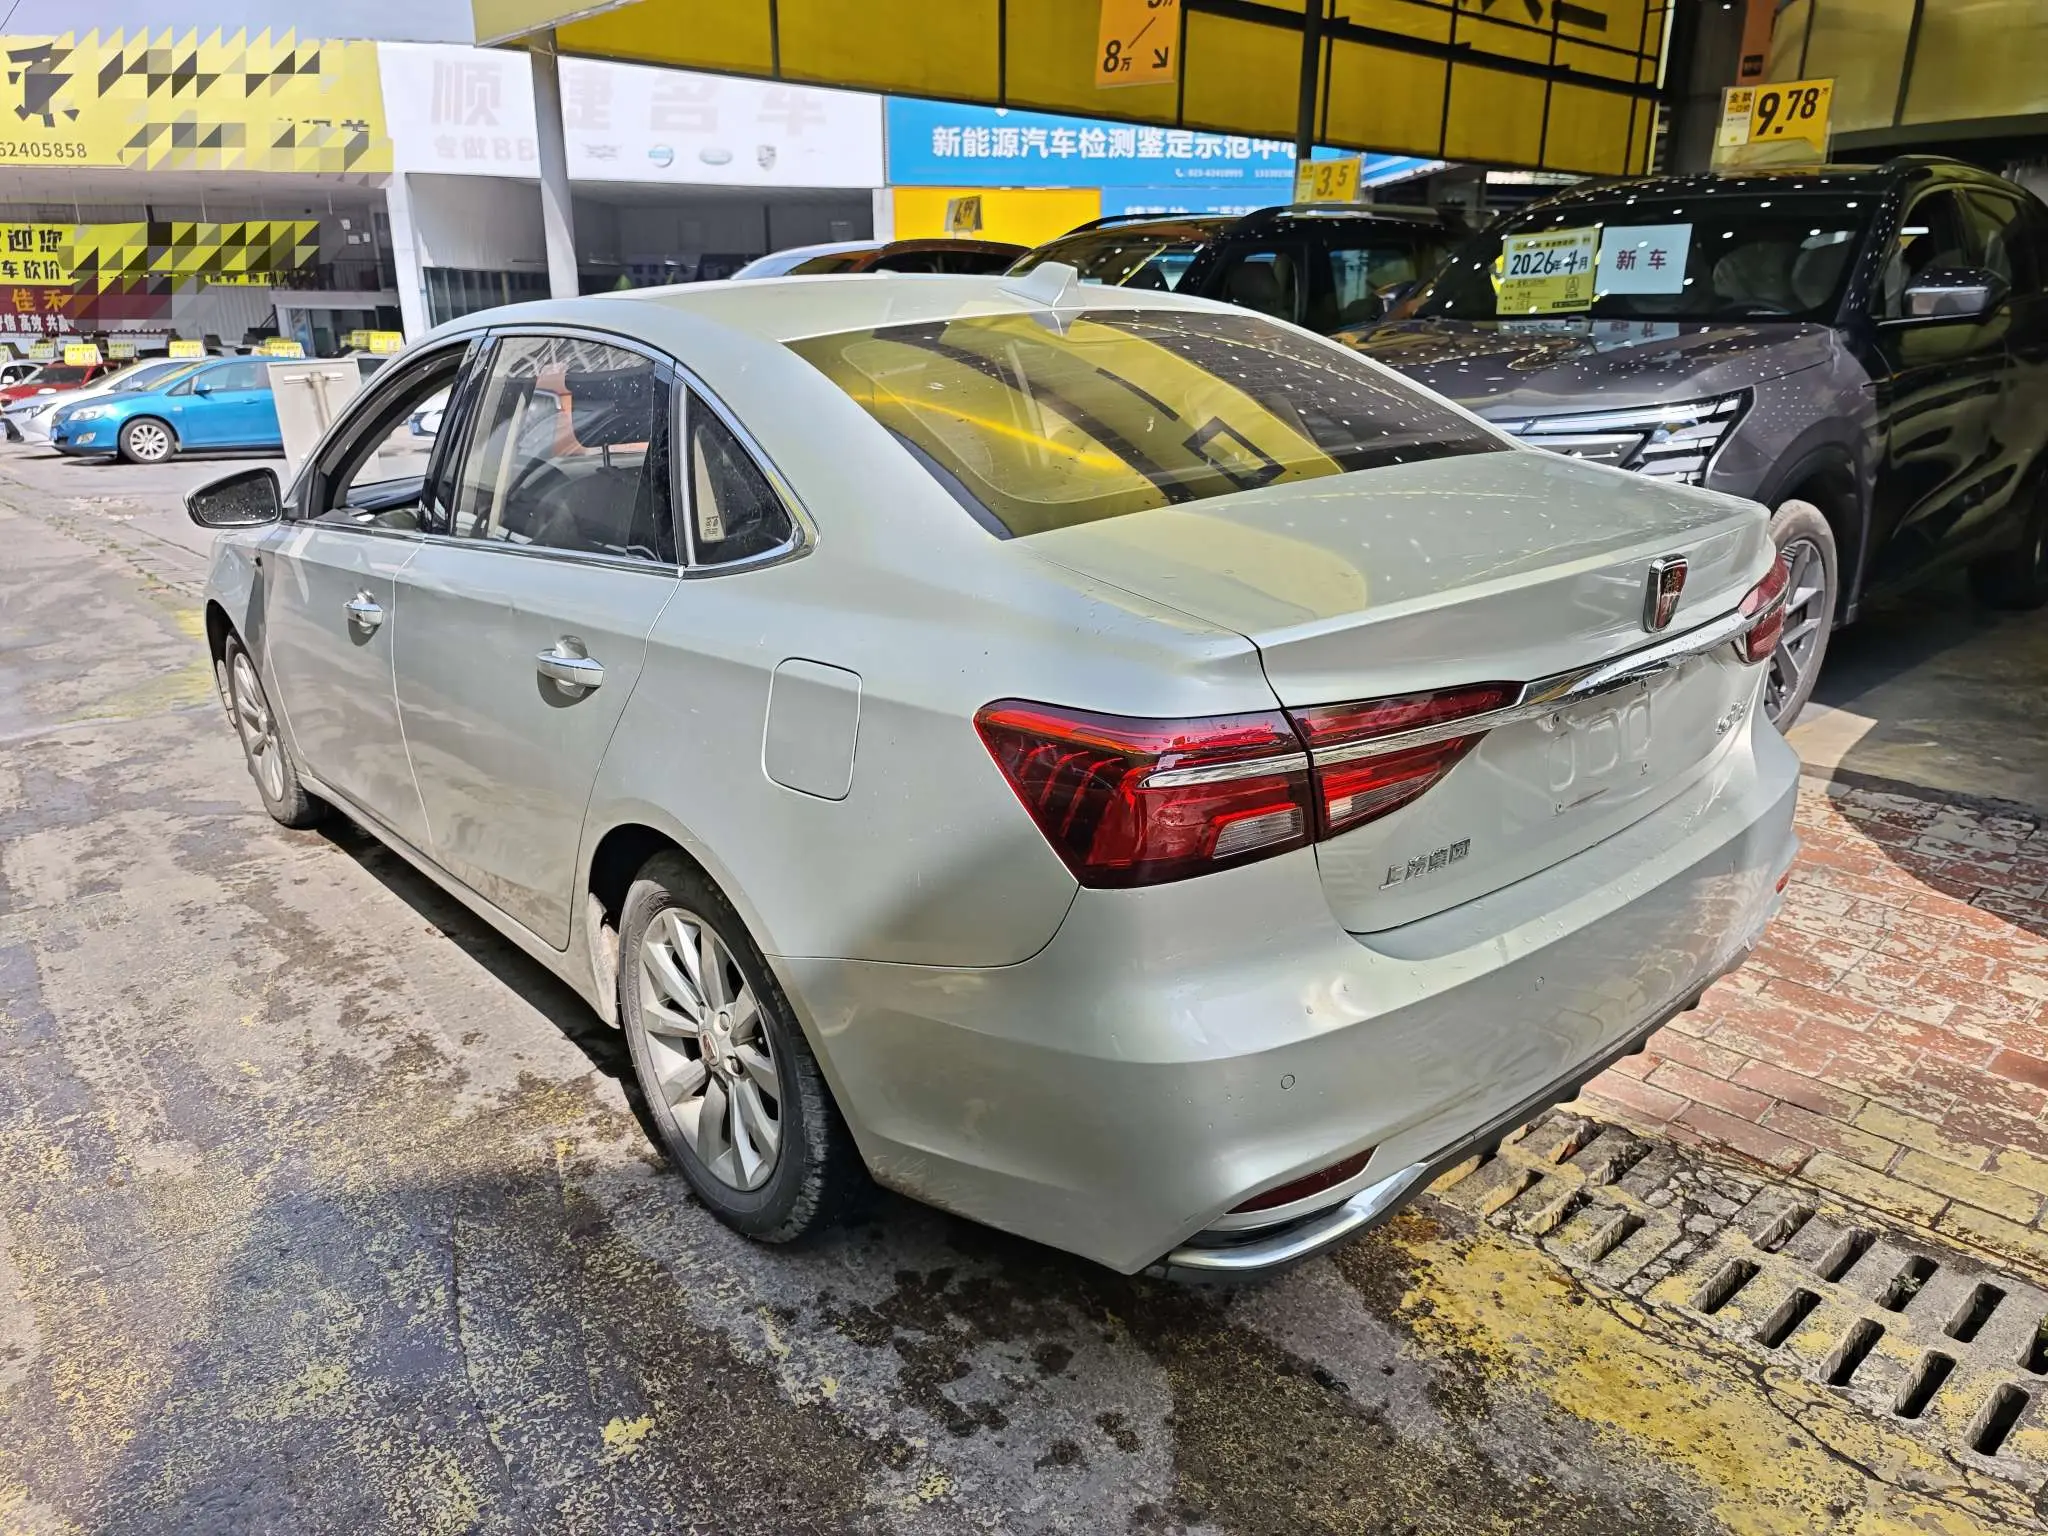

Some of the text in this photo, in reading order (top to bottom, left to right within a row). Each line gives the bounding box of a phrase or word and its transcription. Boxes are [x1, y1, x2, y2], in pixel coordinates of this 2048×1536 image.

[1103, 40, 1132, 73] 8万
[0, 229, 62, 252] 迎您
[1616, 248, 1667, 270] 新车
